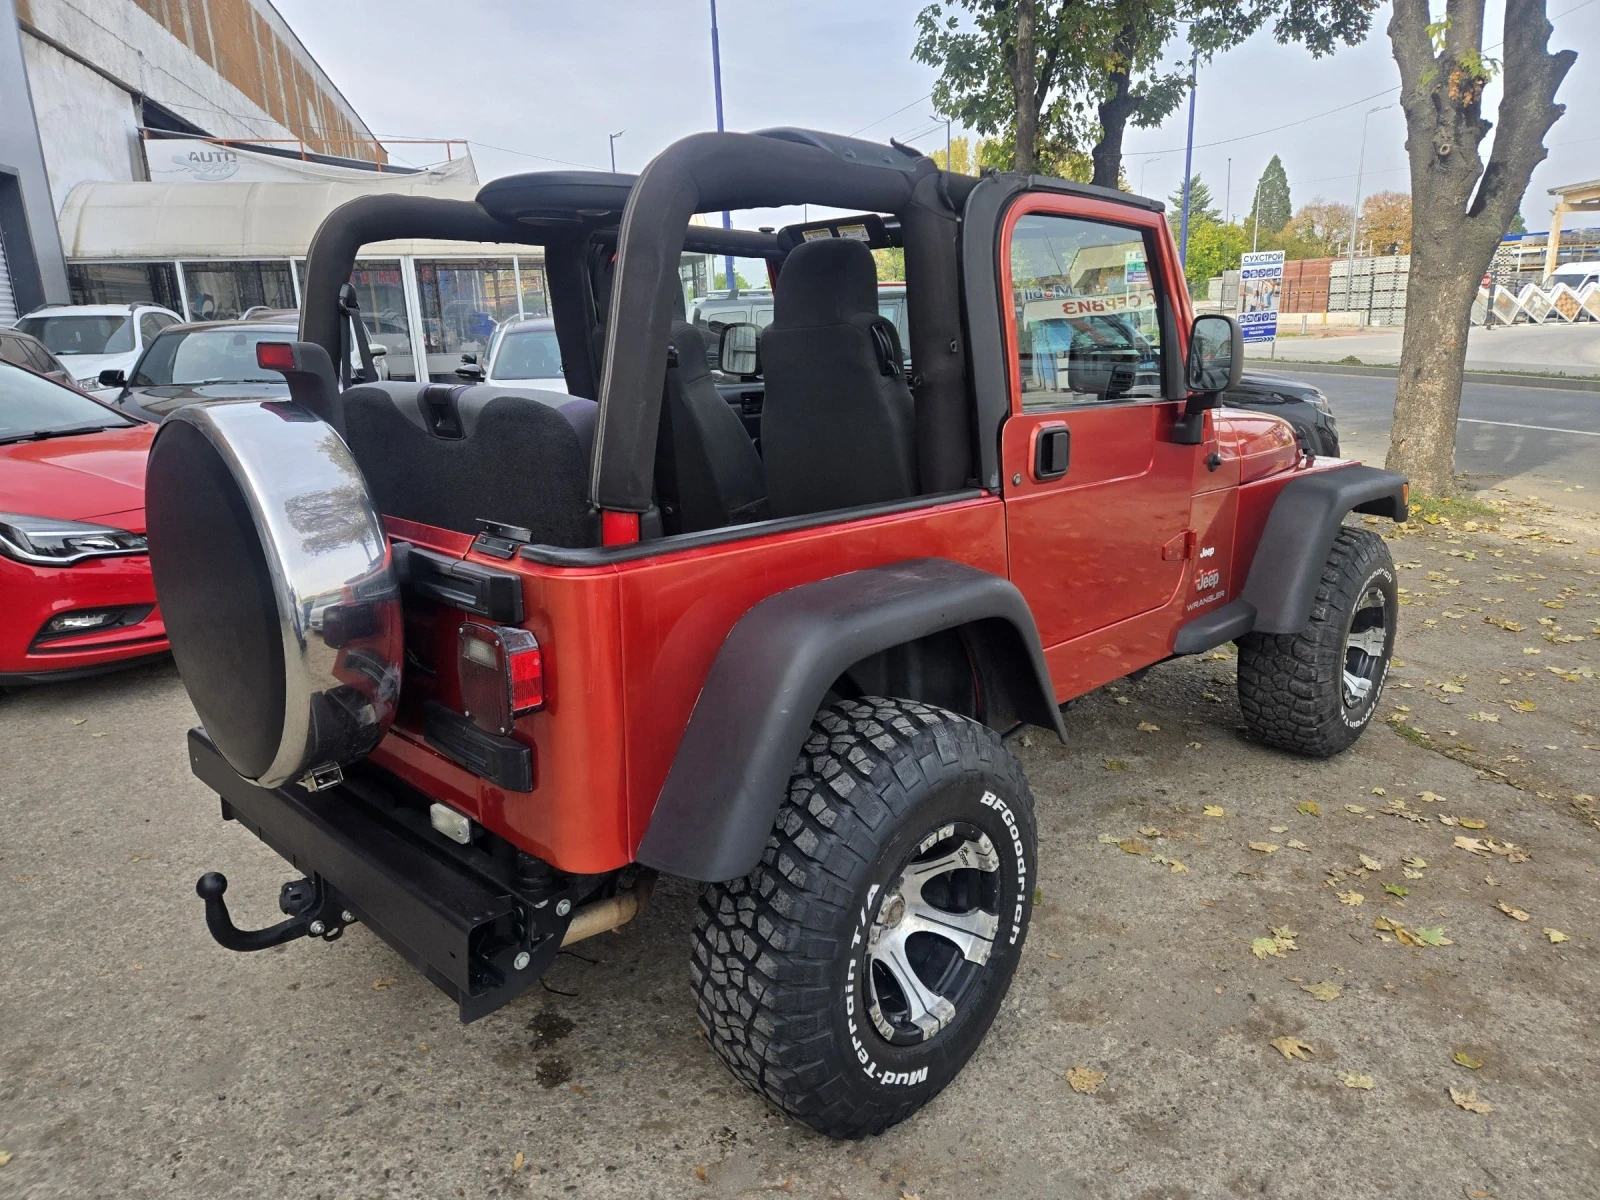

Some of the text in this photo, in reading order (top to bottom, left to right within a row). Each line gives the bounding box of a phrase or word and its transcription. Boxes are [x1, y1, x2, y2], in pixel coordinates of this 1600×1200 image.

[188, 151, 237, 163] AUTO
[1243, 252, 1284, 263] СУХСТРОЙ
[1200, 547, 1215, 558] Jeep
[1196, 571, 1219, 591] Jeep
[1186, 590, 1225, 612] WRANGLER
[980, 790, 1026, 945] BFGoodrich
[845, 884, 929, 1086] Mud-Terrain T/A
